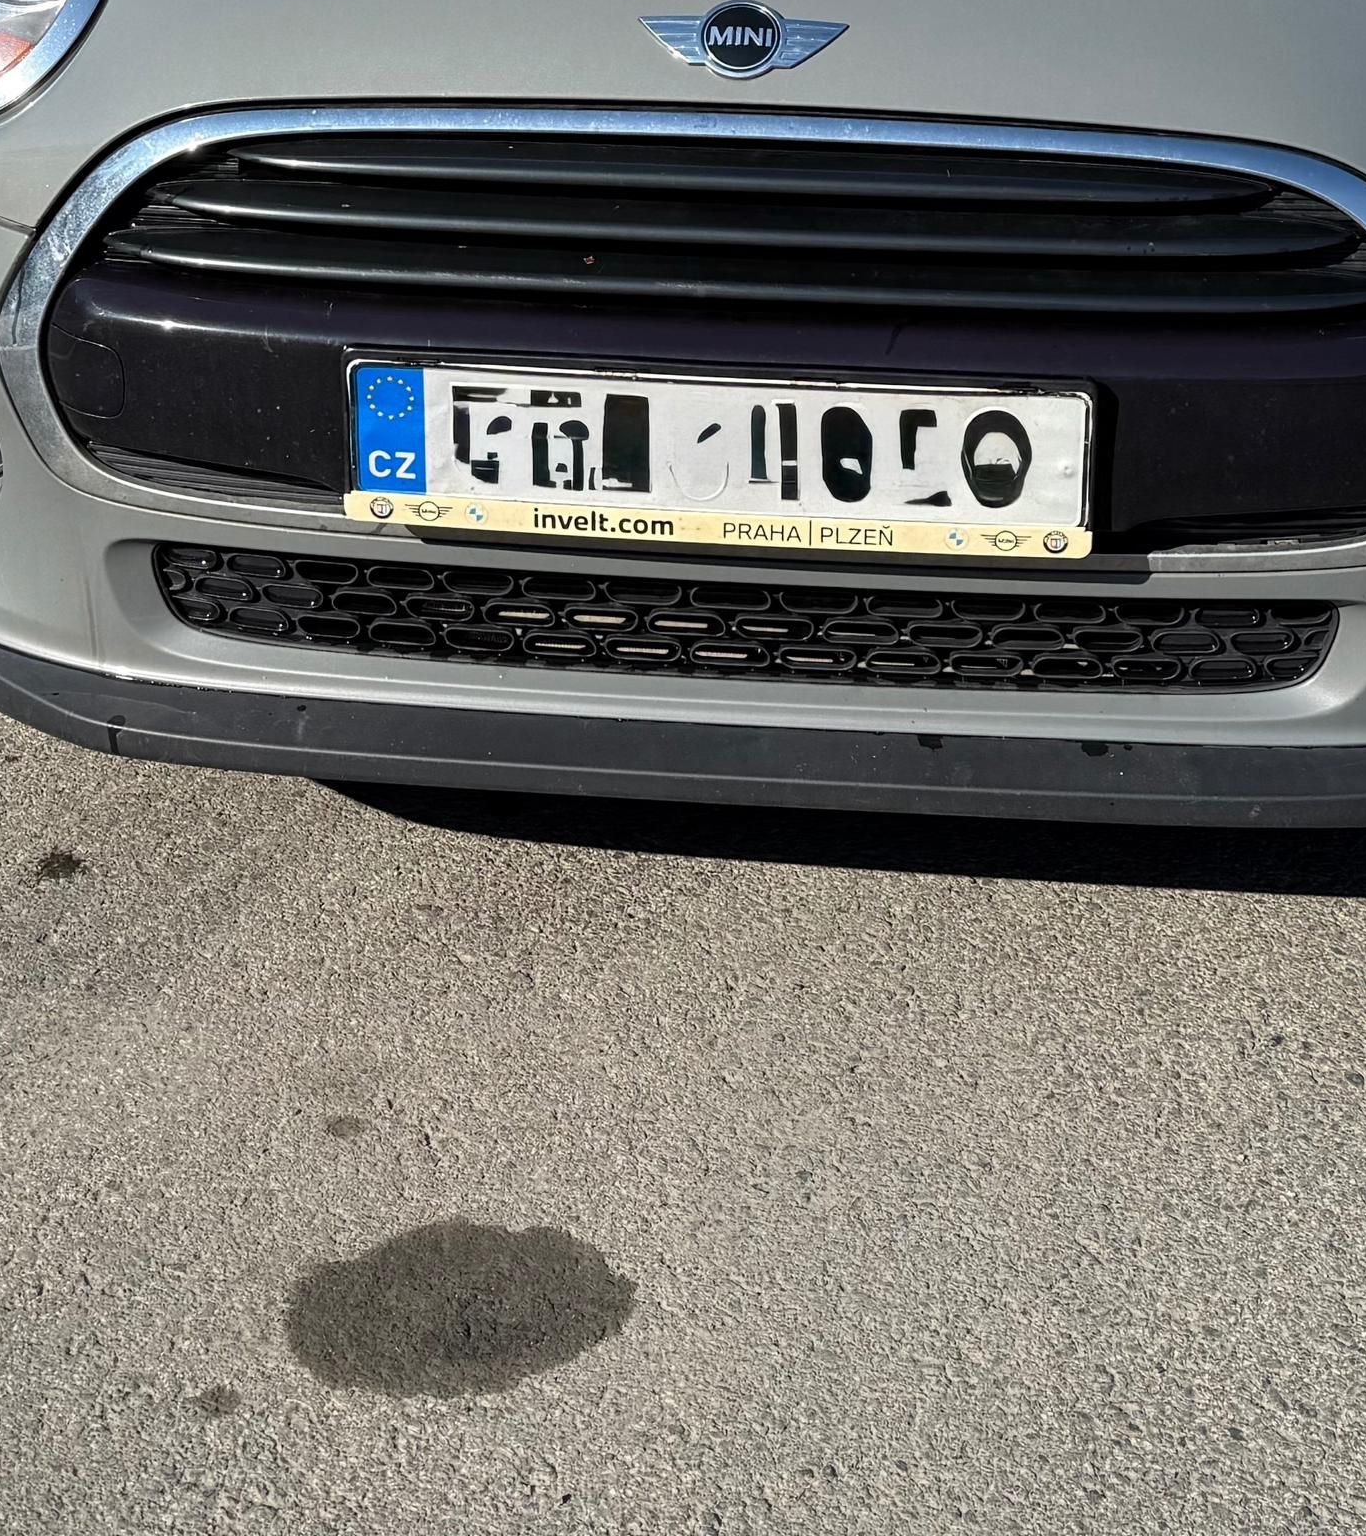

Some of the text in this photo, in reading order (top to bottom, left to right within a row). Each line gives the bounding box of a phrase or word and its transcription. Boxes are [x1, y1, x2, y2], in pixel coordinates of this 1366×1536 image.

[708, 25, 774, 48] MINI
[367, 449, 417, 481] CZ
[533, 507, 675, 536] invelt.com
[722, 522, 894, 546] PRAHA PLZEŇ
